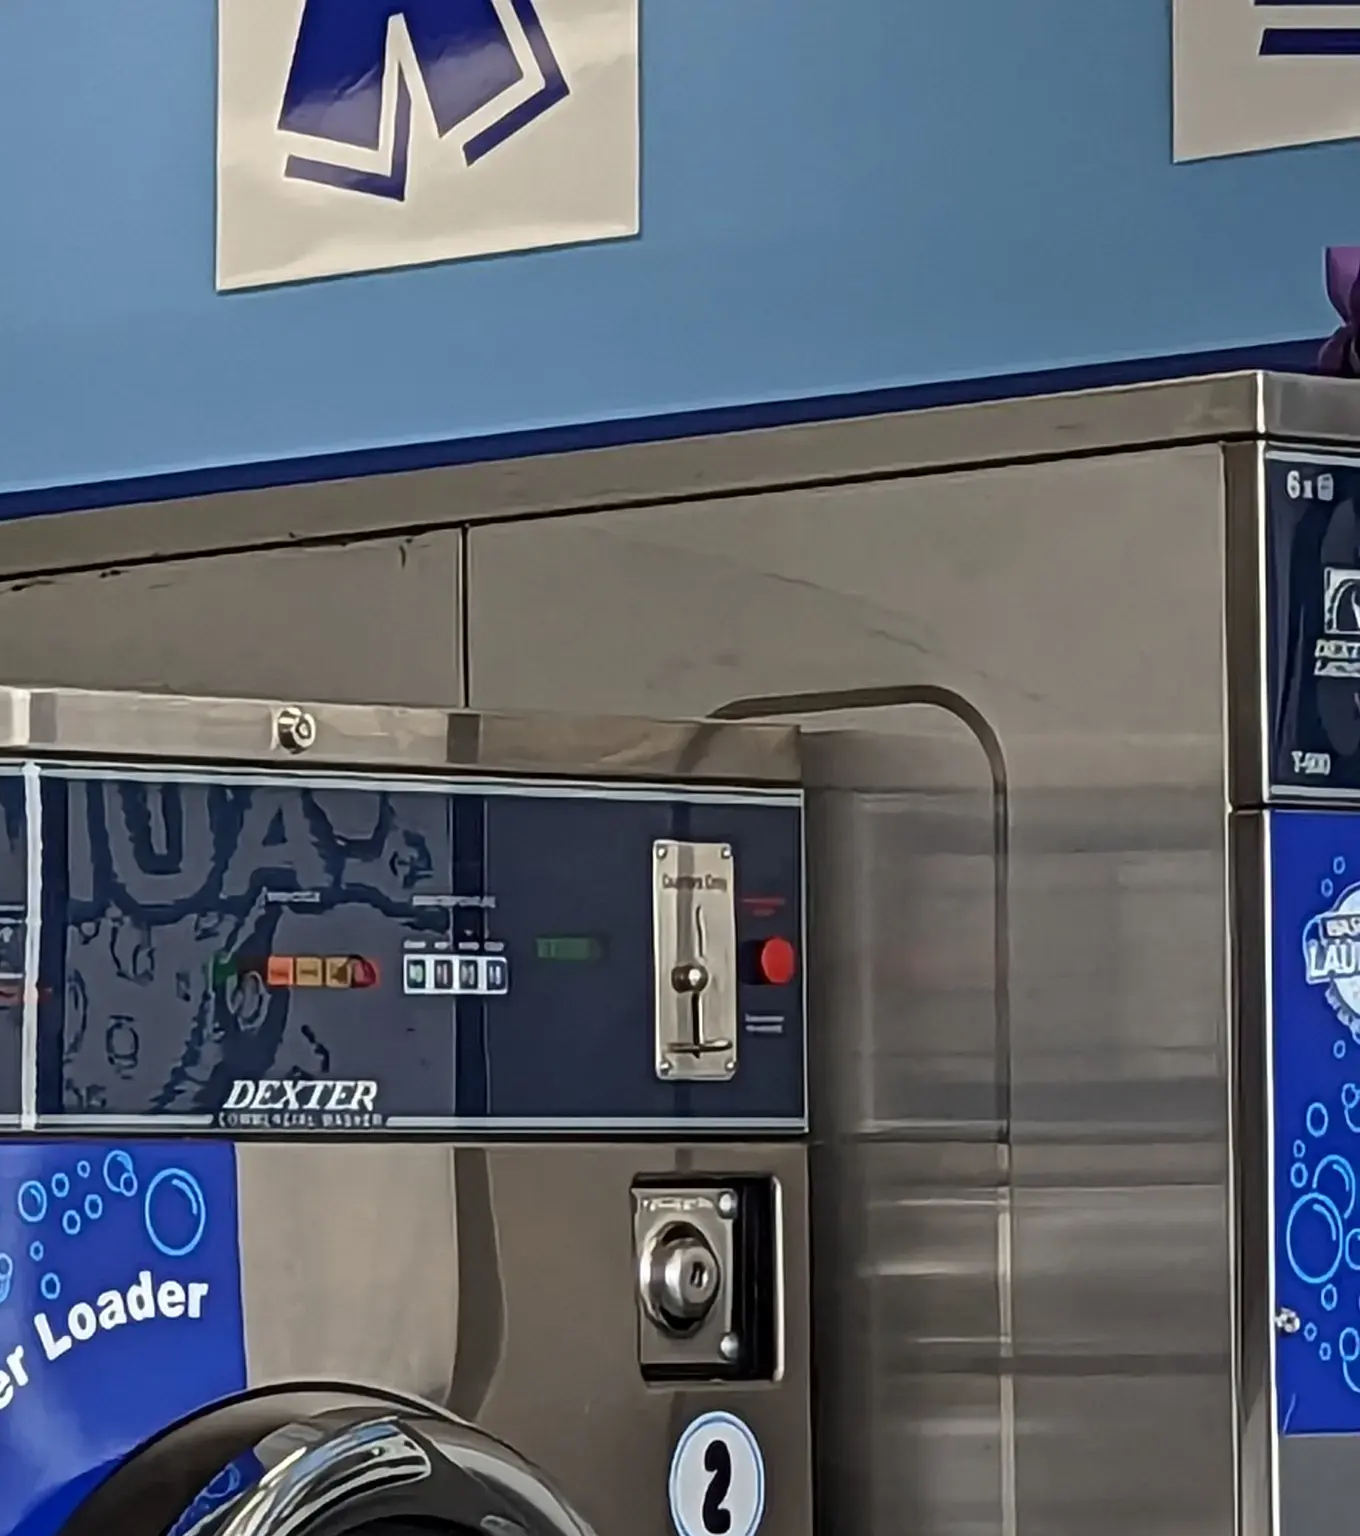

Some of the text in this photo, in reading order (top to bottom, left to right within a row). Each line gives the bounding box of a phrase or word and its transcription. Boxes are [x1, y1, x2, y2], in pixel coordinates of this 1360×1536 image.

[1287, 470, 1301, 499] 6
[1309, 943, 1360, 977] LAU
[222, 1079, 378, 1112] DEXTER
[34, 1270, 209, 1361] Loader
[701, 1439, 732, 1535] 2
